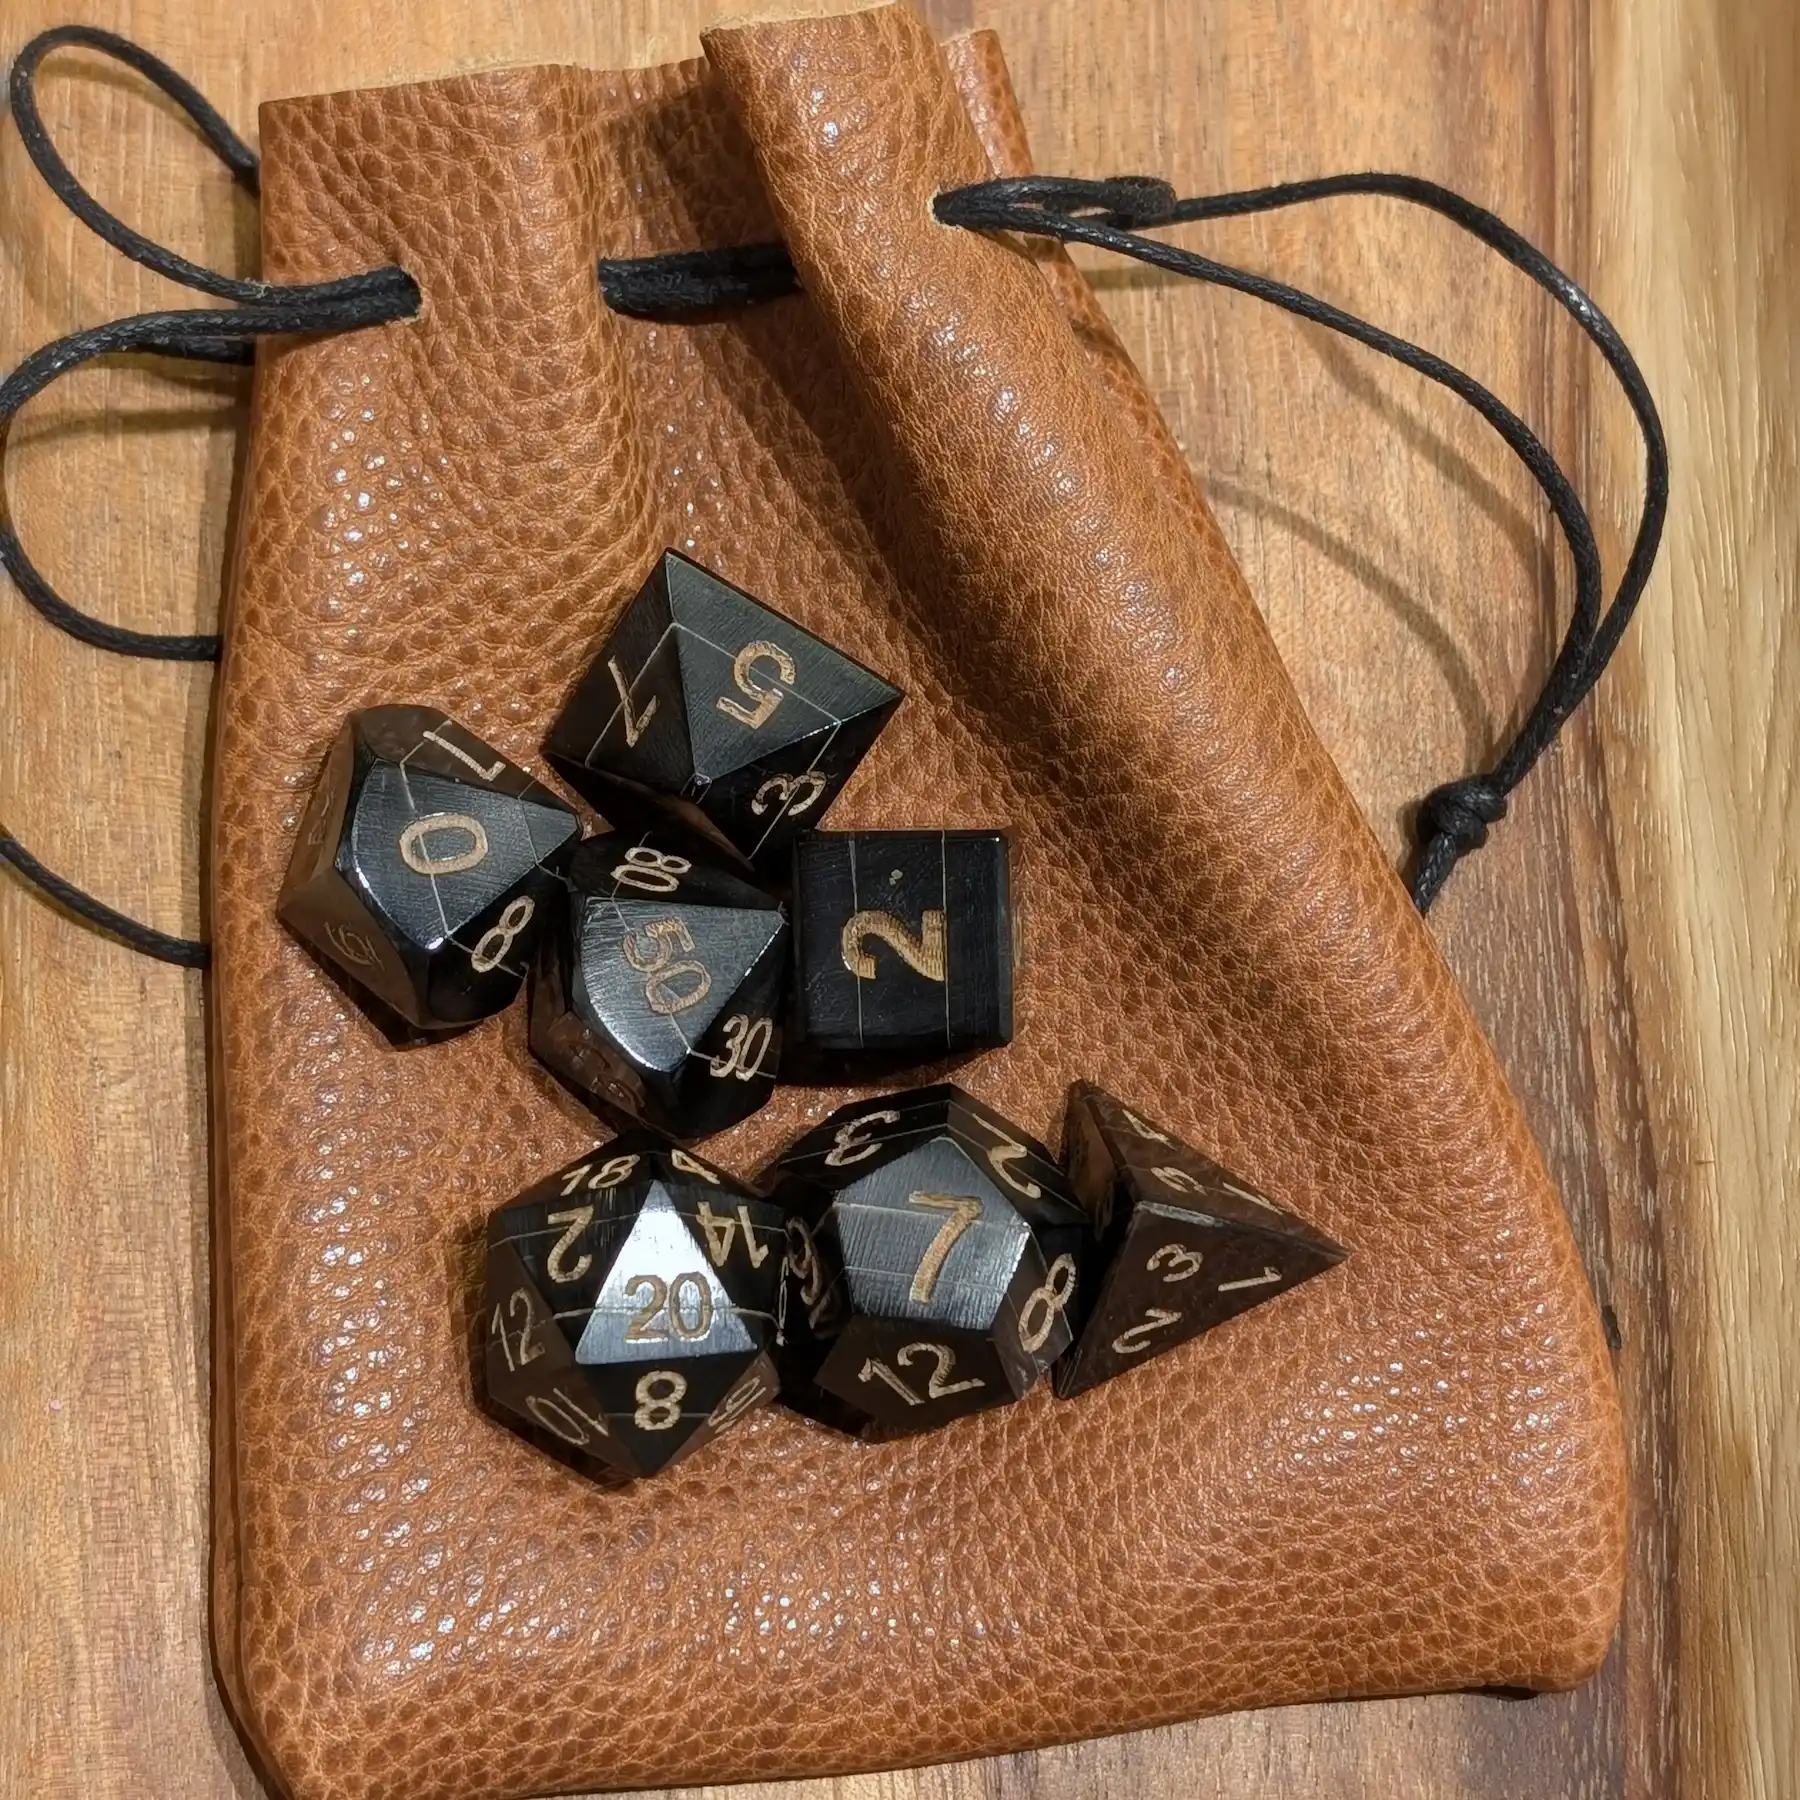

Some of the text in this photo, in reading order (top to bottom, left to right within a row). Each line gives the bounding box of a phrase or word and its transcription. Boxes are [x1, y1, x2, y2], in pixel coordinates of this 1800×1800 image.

[716, 640, 796, 730] 5
[751, 771, 827, 817] 3
[399, 812, 488, 876] 0
[611, 846, 692, 892] 80
[471, 895, 535, 973] 8
[623, 916, 711, 1014] 50
[841, 909, 948, 981] 2
[709, 1014, 772, 1082] 30
[672, 1149, 720, 1184] 4
[824, 1110, 900, 1167] 3
[972, 1113, 1041, 1199] 2
[560, 1154, 640, 1197] 18
[547, 1204, 594, 1283] 2
[696, 1201, 770, 1269] 14
[908, 1189, 983, 1306] 7
[1146, 1244, 1203, 1282] 3
[622, 1271, 716, 1342] 20
[1018, 1252, 1076, 1354] 8
[1217, 1266, 1282, 1291] 1
[491, 1287, 546, 1372] 12
[1112, 1308, 1183, 1354] 2
[634, 1370, 688, 1431] 8
[858, 1342, 986, 1406] 12
[526, 1387, 609, 1444] 10
